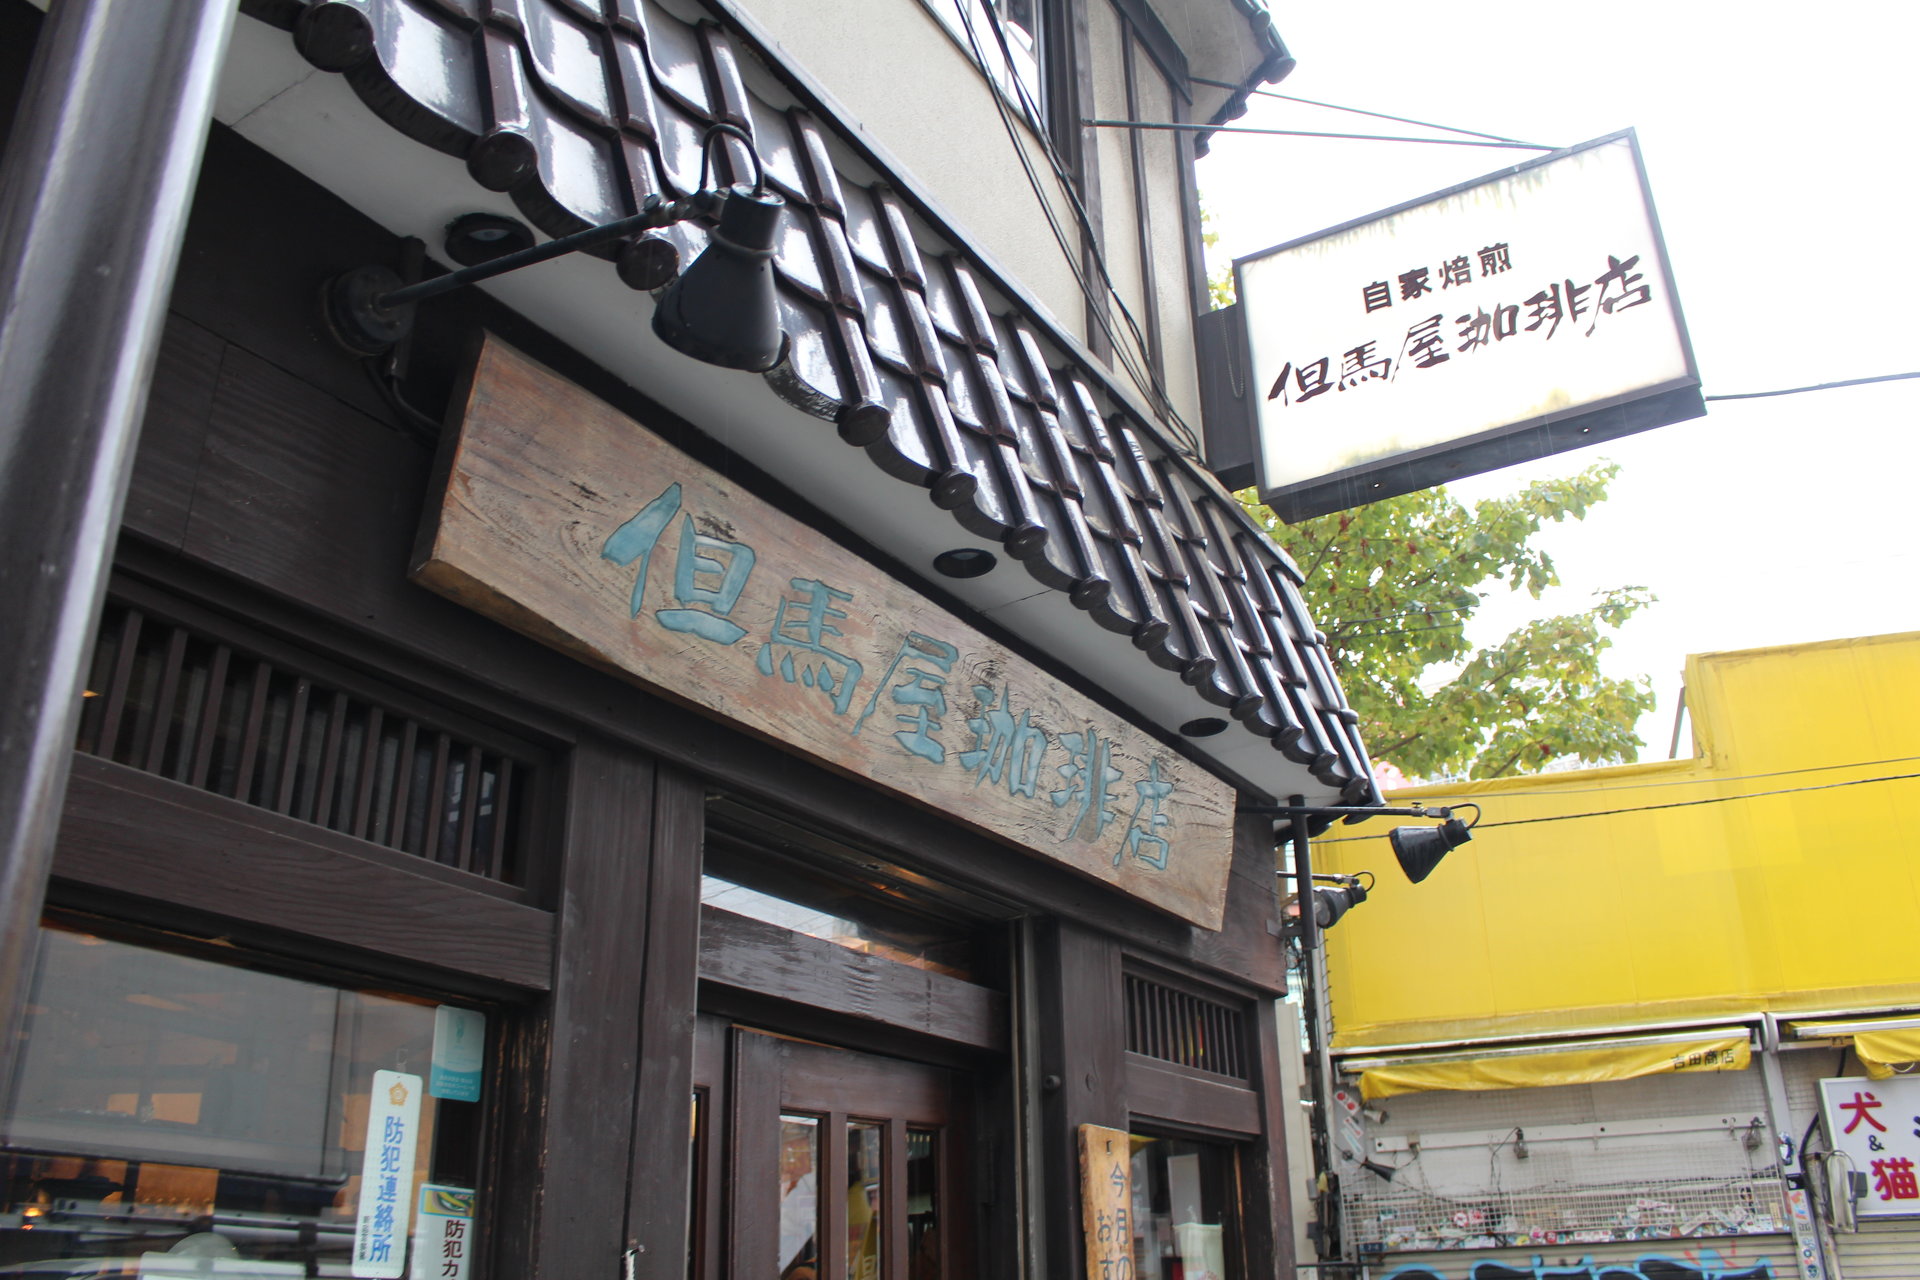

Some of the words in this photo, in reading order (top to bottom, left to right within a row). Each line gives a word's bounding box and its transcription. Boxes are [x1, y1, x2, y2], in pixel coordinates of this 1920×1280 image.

[1268, 254, 1653, 407] 但馬屋珈琲店
[1362, 242, 1513, 314] 自家焙煎
[602, 482, 1175, 870] 但馬屋珈琲店
[1670, 1048, 1734, 1070] 吉田商店
[369, 1115, 405, 1263] 防犯連絡所
